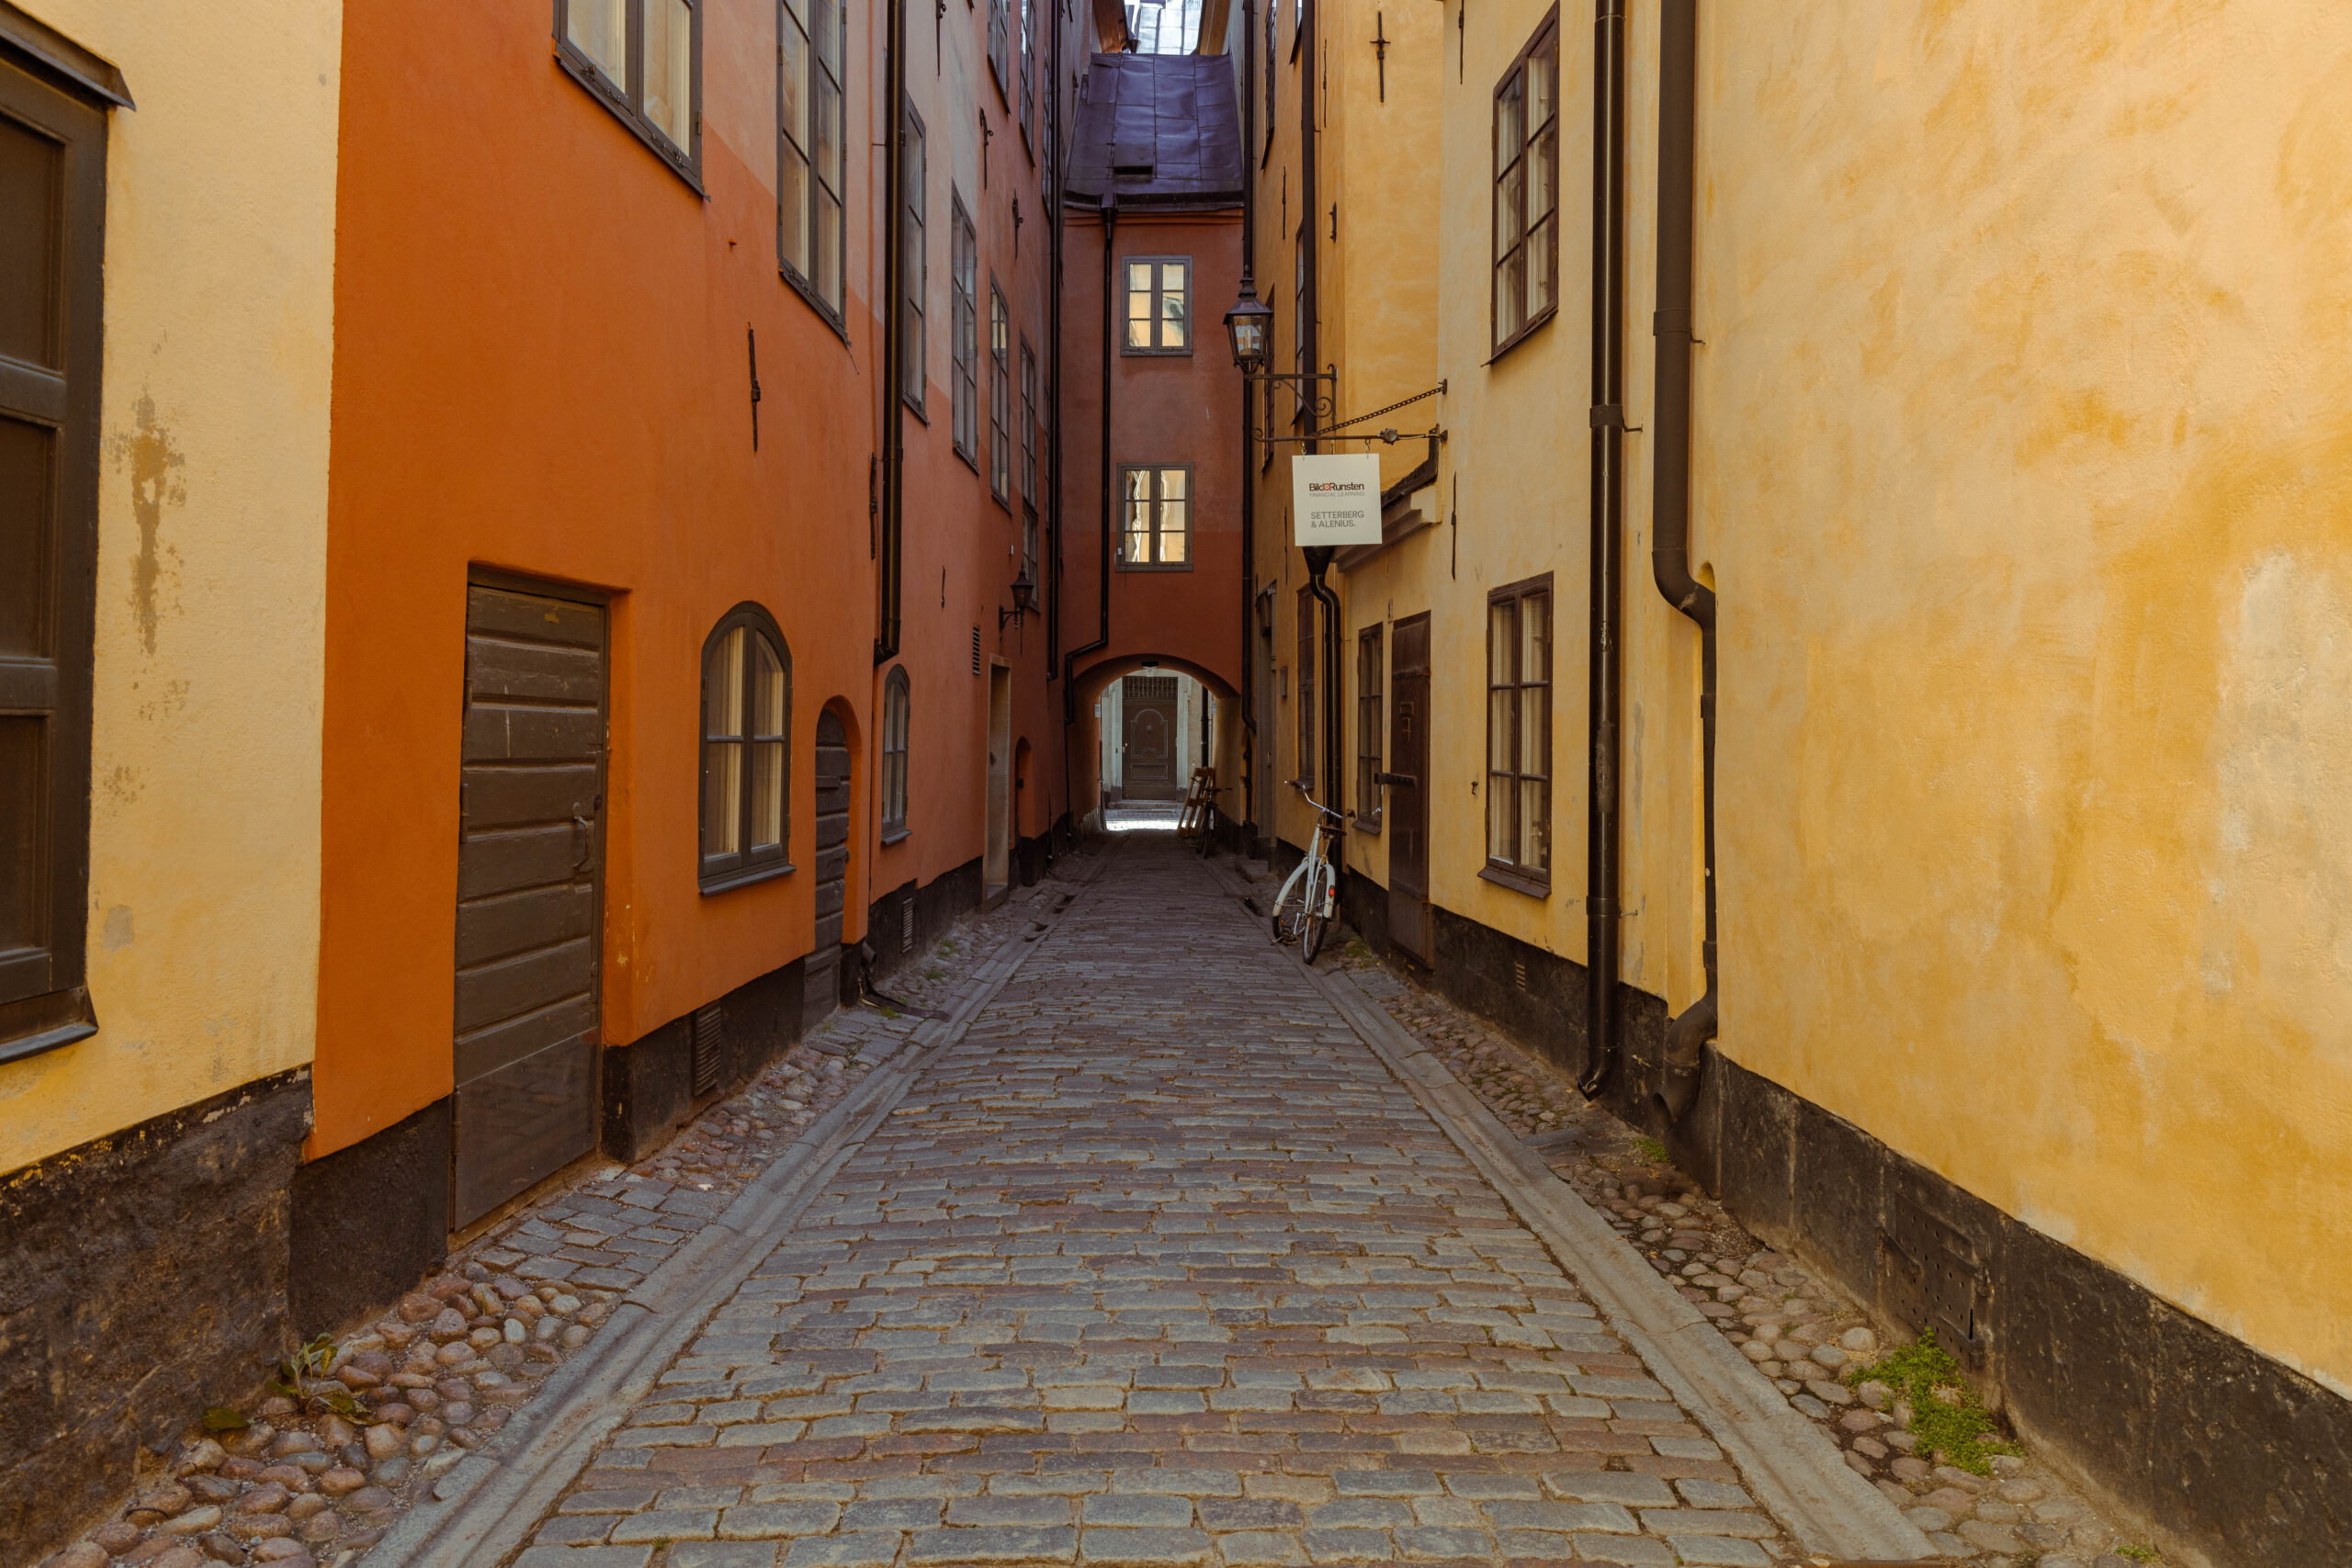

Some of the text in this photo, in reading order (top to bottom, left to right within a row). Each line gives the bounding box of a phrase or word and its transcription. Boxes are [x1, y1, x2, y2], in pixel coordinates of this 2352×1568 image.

[1311, 511, 1364, 520] SETTERBERG
[1311, 519, 1356, 528] & ALENIUS.
